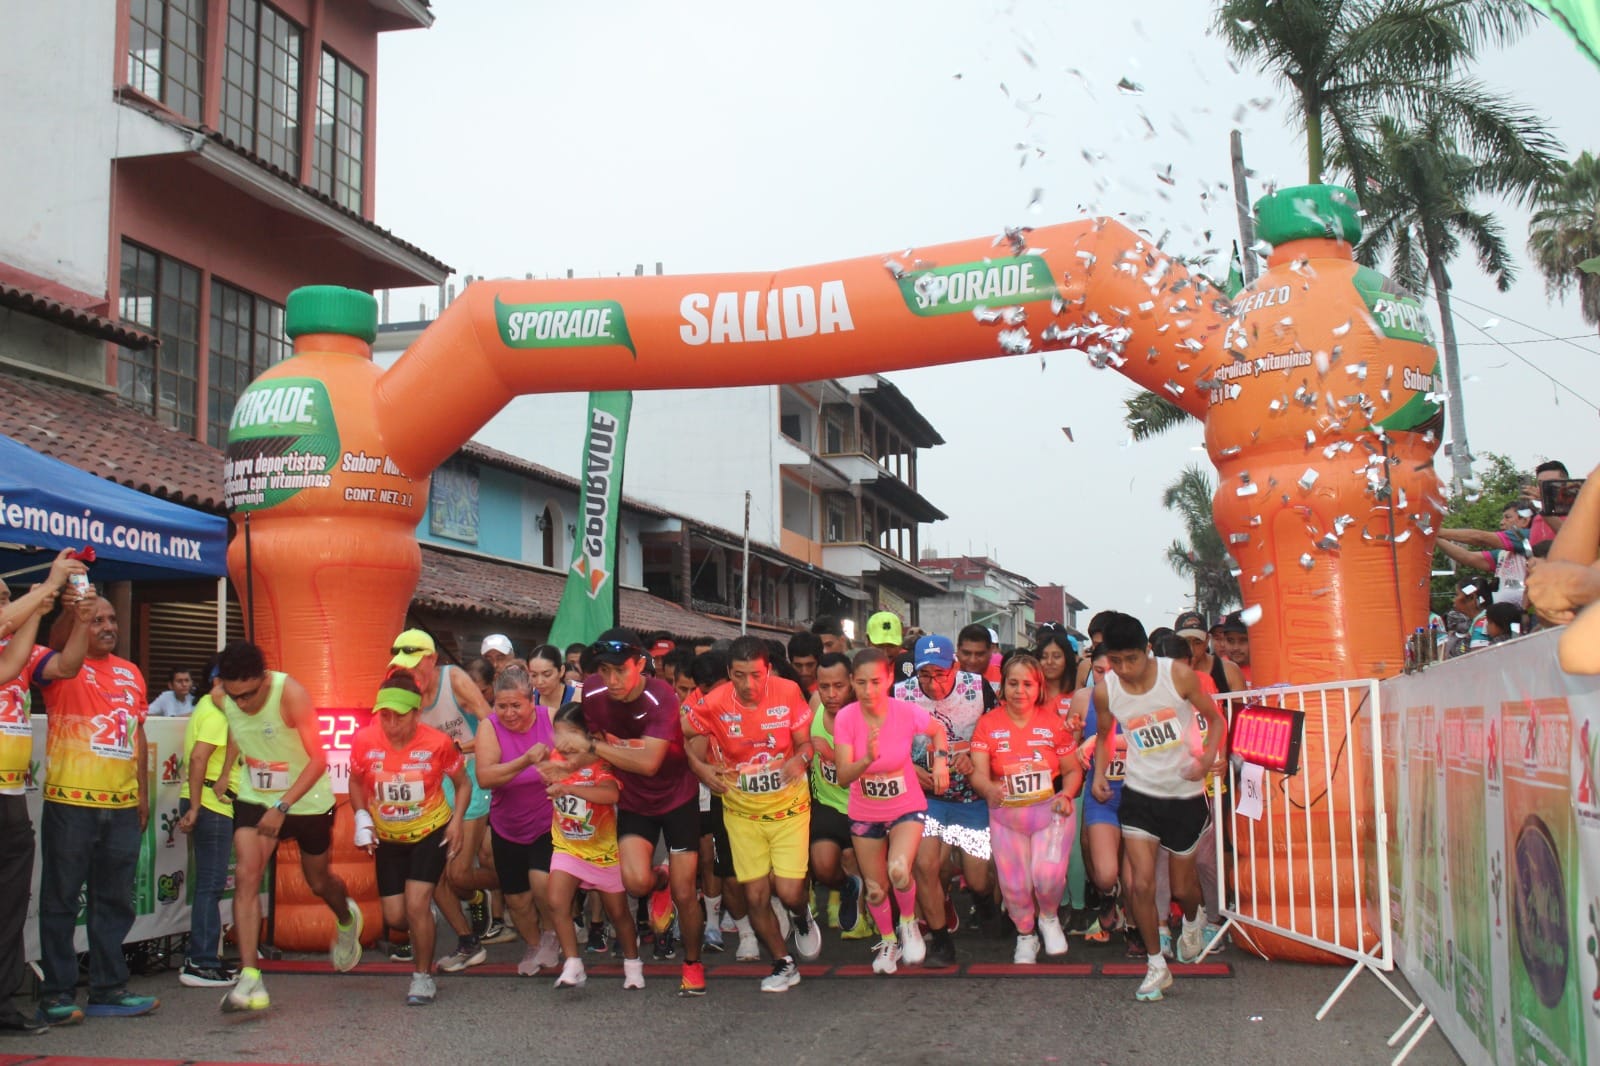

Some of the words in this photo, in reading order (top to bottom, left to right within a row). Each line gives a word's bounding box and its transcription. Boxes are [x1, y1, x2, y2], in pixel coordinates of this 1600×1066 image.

[914, 262, 1036, 309] SPORADE
[679, 279, 855, 346] SALIDA
[508, 307, 612, 342] SPORADE
[1403, 367, 1432, 391] Sabor
[229, 386, 315, 431] PORADE
[255, 451, 327, 477] deportistas
[342, 451, 382, 473] Sabor
[249, 475, 268, 491] con
[270, 470, 332, 489] vitaminas
[345, 487, 377, 502] CONT.
[379, 489, 400, 505] NET.
[1139, 721, 1177, 748] 394
[256, 772, 273, 789] 17
[748, 771, 781, 792] 436
[866, 780, 900, 797] 328
[1015, 773, 1041, 794] 577
[387, 783, 412, 801] 56
